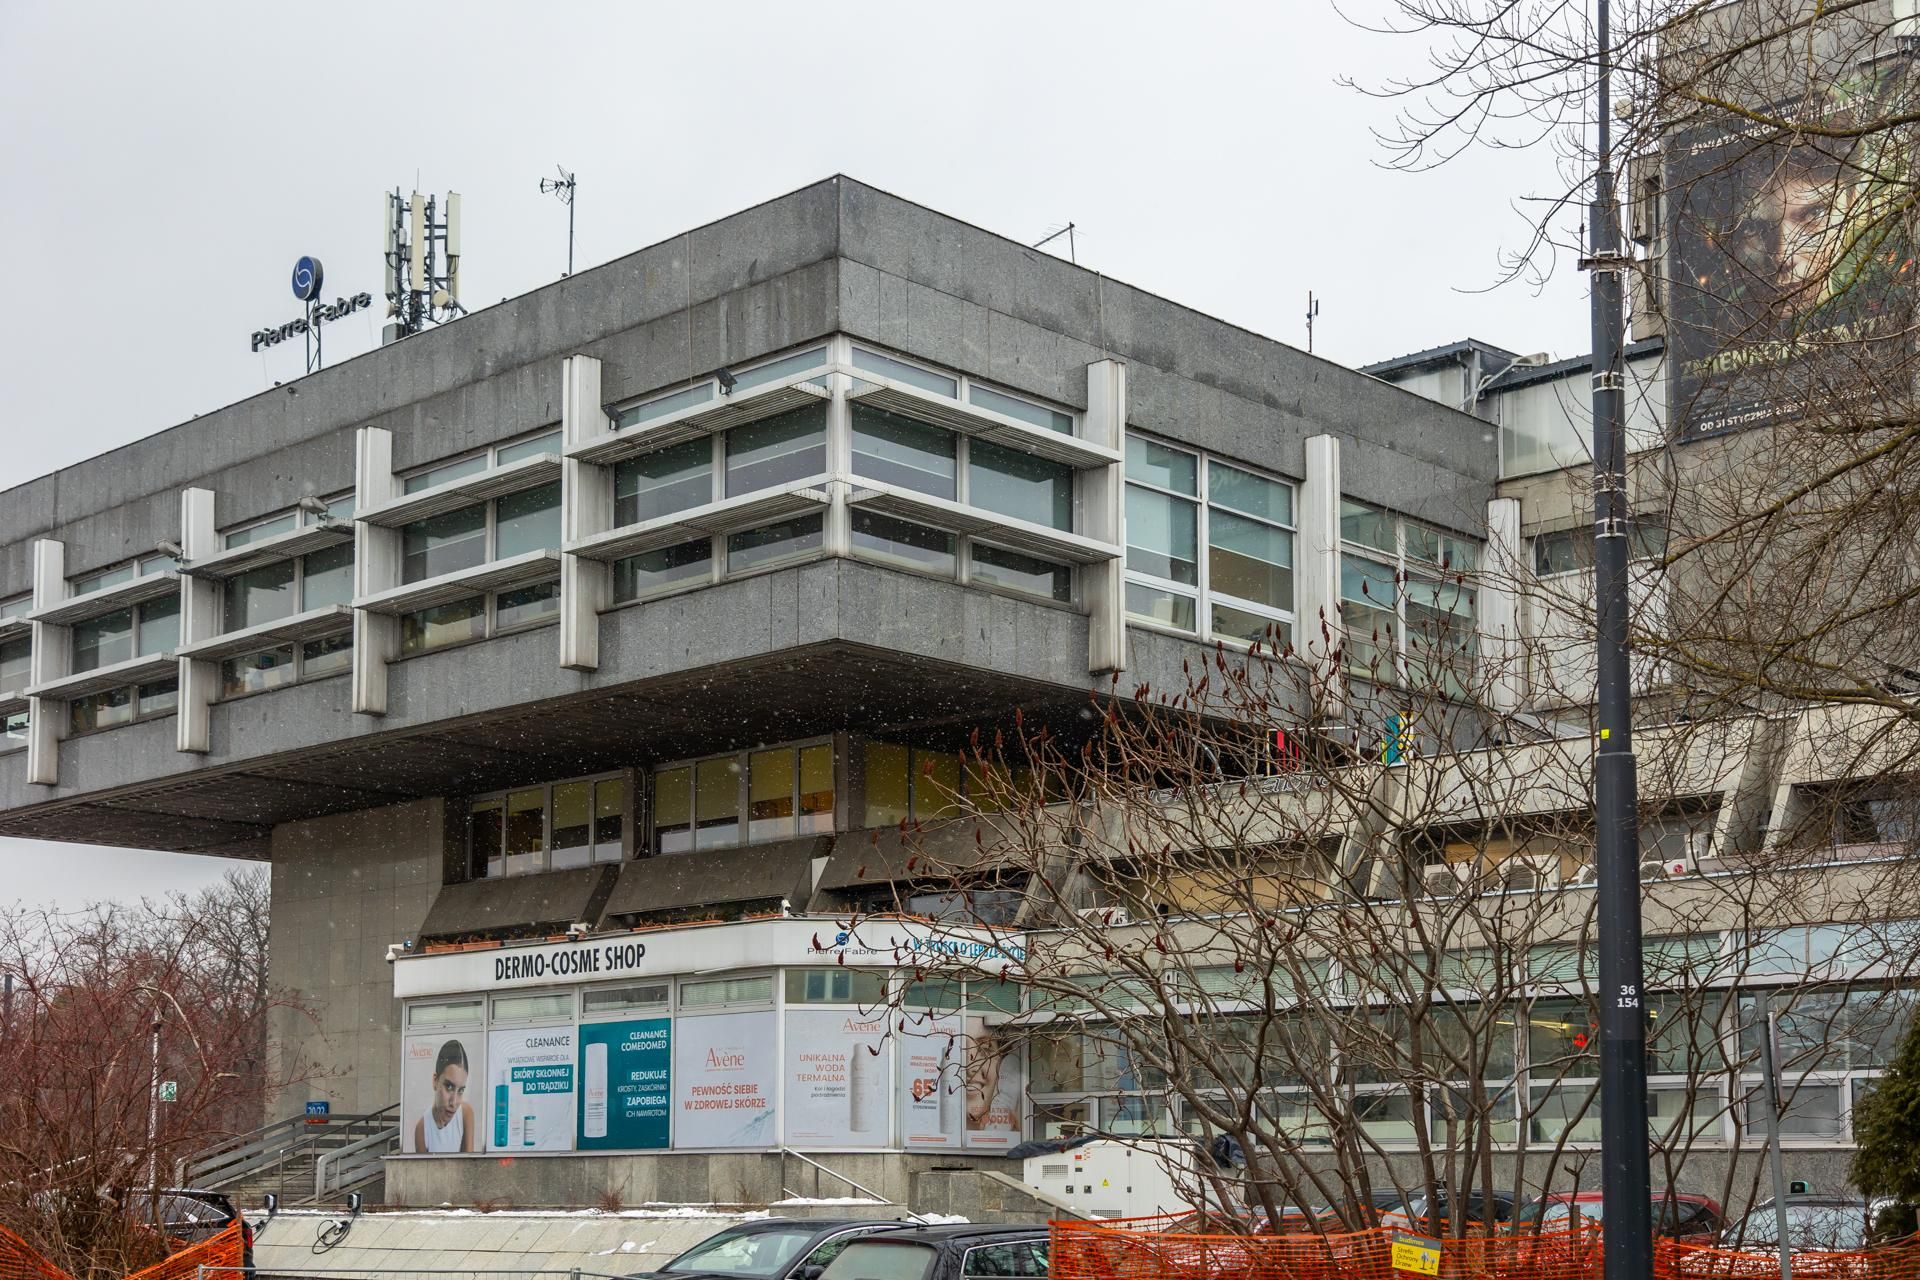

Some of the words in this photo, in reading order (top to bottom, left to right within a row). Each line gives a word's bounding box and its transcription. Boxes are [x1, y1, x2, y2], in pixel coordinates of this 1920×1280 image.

[251, 318, 309, 352] Pierre
[312, 292, 371, 326] Fabre
[1700, 420, 1714, 432] OD
[807, 947, 843, 955] Pierre
[845, 947, 878, 955] Fabre
[960, 942, 967, 955] O
[495, 949, 600, 980] DERMO-COSME
[605, 944, 646, 971] SHOP
[1620, 984, 1636, 996] 36
[1616, 997, 1639, 1008] 154
[630, 1030, 667, 1040] CLEANANCE
[525, 1036, 570, 1049] CLEANANCE
[621, 1040, 667, 1052] COMEDOMED
[706, 1047, 745, 1067] Avène
[799, 1054, 846, 1062] UNIKALNA
[513, 1068, 534, 1080] SKÓRY
[535, 1068, 569, 1079] SKŁONNEJ
[815, 1064, 846, 1072] WODA
[631, 1070, 667, 1081] REDUKUJE
[796, 1074, 846, 1082] TERMALNA
[526, 1083, 536, 1092] DO
[537, 1081, 569, 1093] TRĄDZIKU
[692, 1083, 732, 1096] PEWNOŚĆ
[734, 1084, 758, 1095] SIEBIE
[627, 1096, 667, 1106] ZAPOBIEGA
[684, 1100, 693, 1110] W
[694, 1100, 732, 1110] ZDROWEJ
[734, 1096, 766, 1109] SKÓRZE
[626, 1110, 636, 1118] ICH
[636, 1108, 667, 1117] NAWROTOM
[1397, 1246, 1414, 1255] Strefa
[1396, 1253, 1418, 1263] Ochrony
